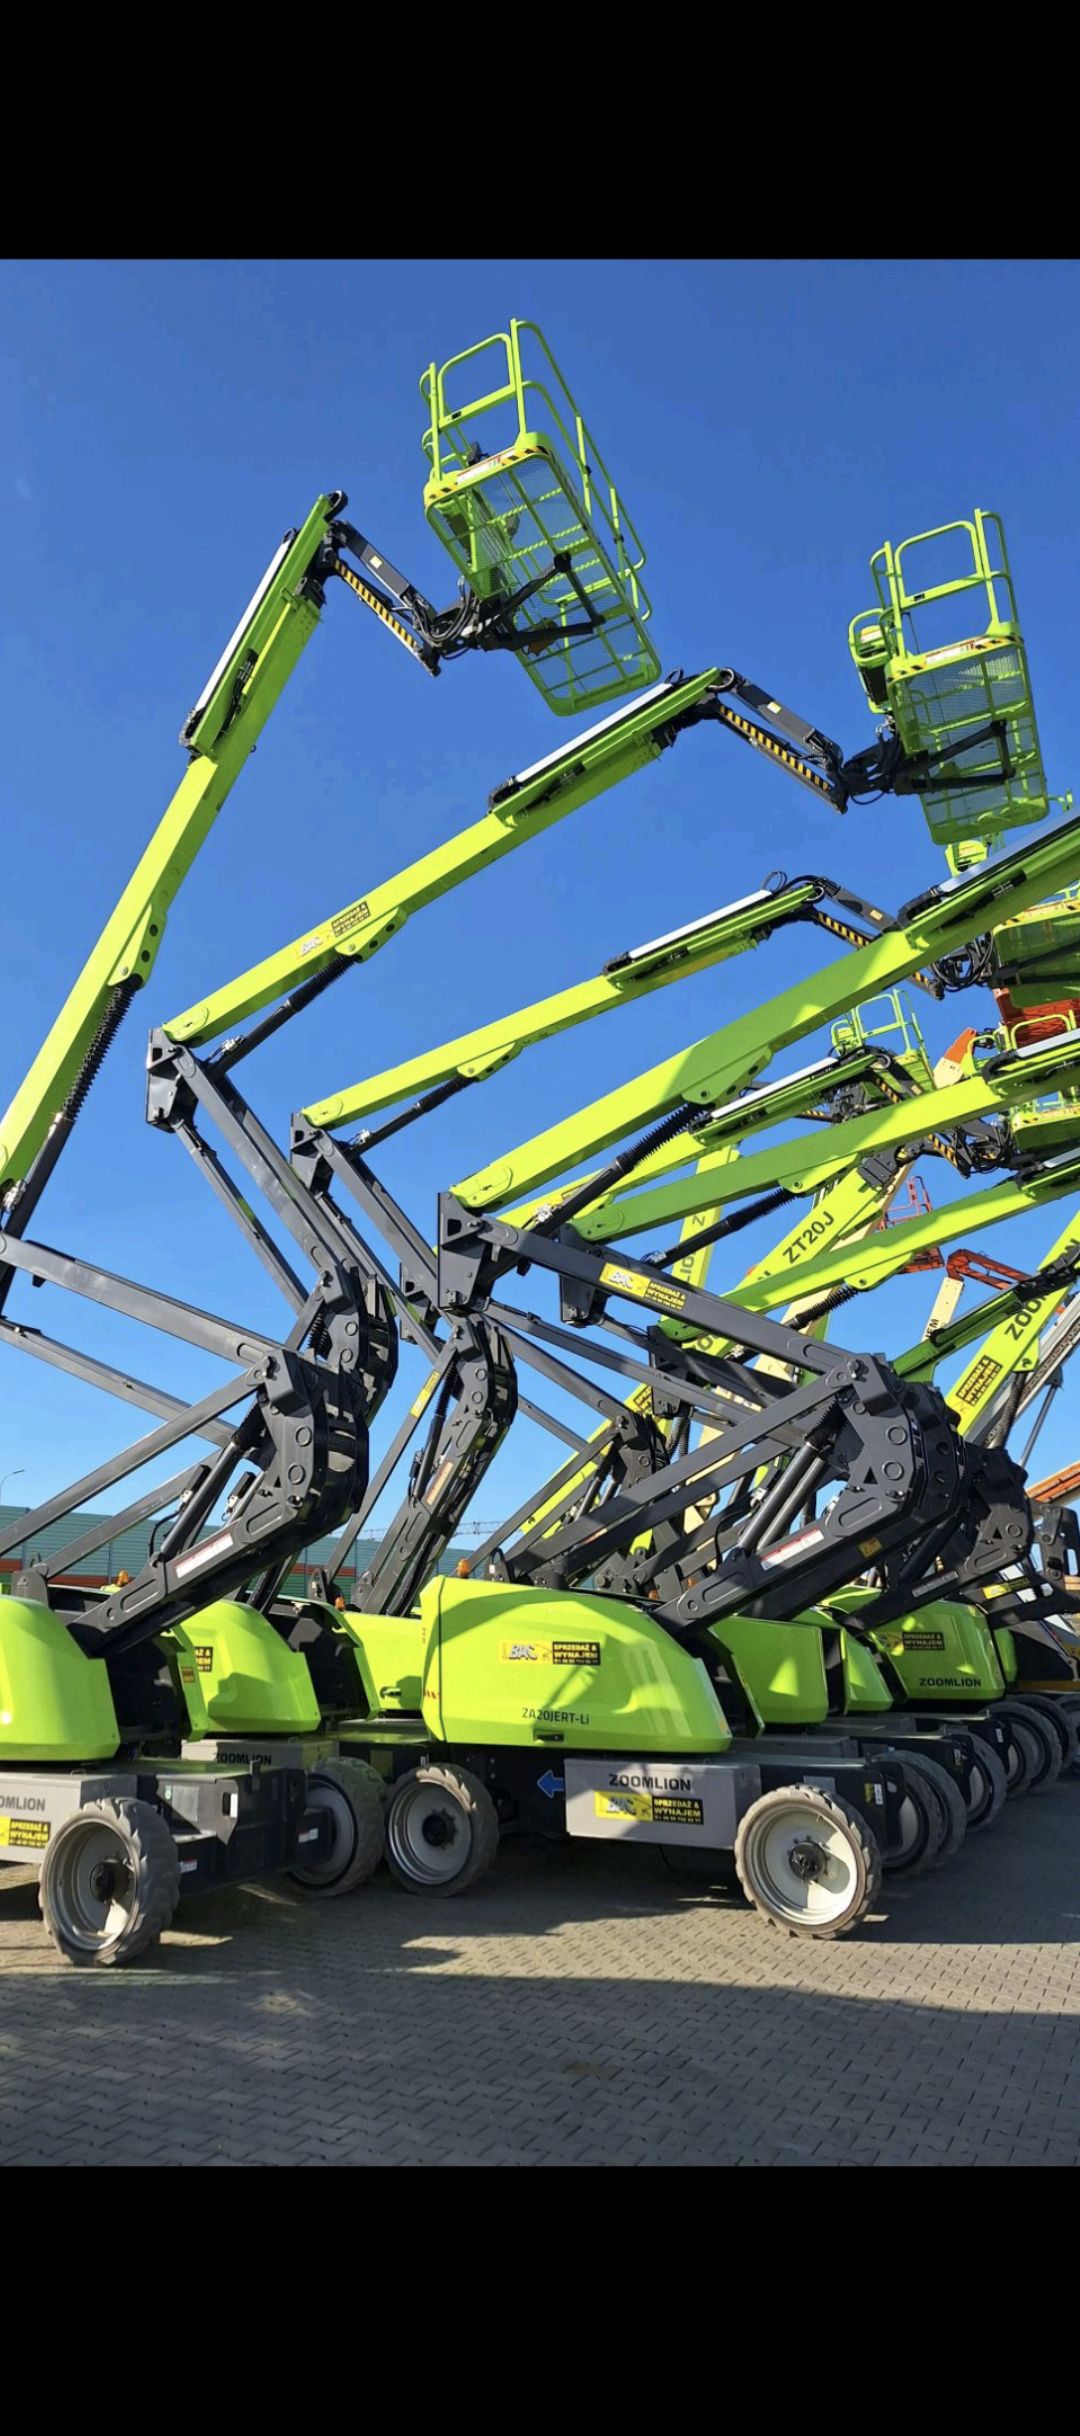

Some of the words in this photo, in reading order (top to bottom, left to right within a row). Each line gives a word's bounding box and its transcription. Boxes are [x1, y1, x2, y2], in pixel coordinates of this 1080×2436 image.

[782, 1211, 835, 1265] ZT20J
[553, 1644, 590, 1652] SPRZEDAŻ
[918, 1678, 982, 1688] ZOOMLION
[608, 1773, 692, 1791] ZOOMLION
[653, 1798, 692, 1809] SPRZEDAŻ
[653, 1807, 702, 1817] WYNAJEM
